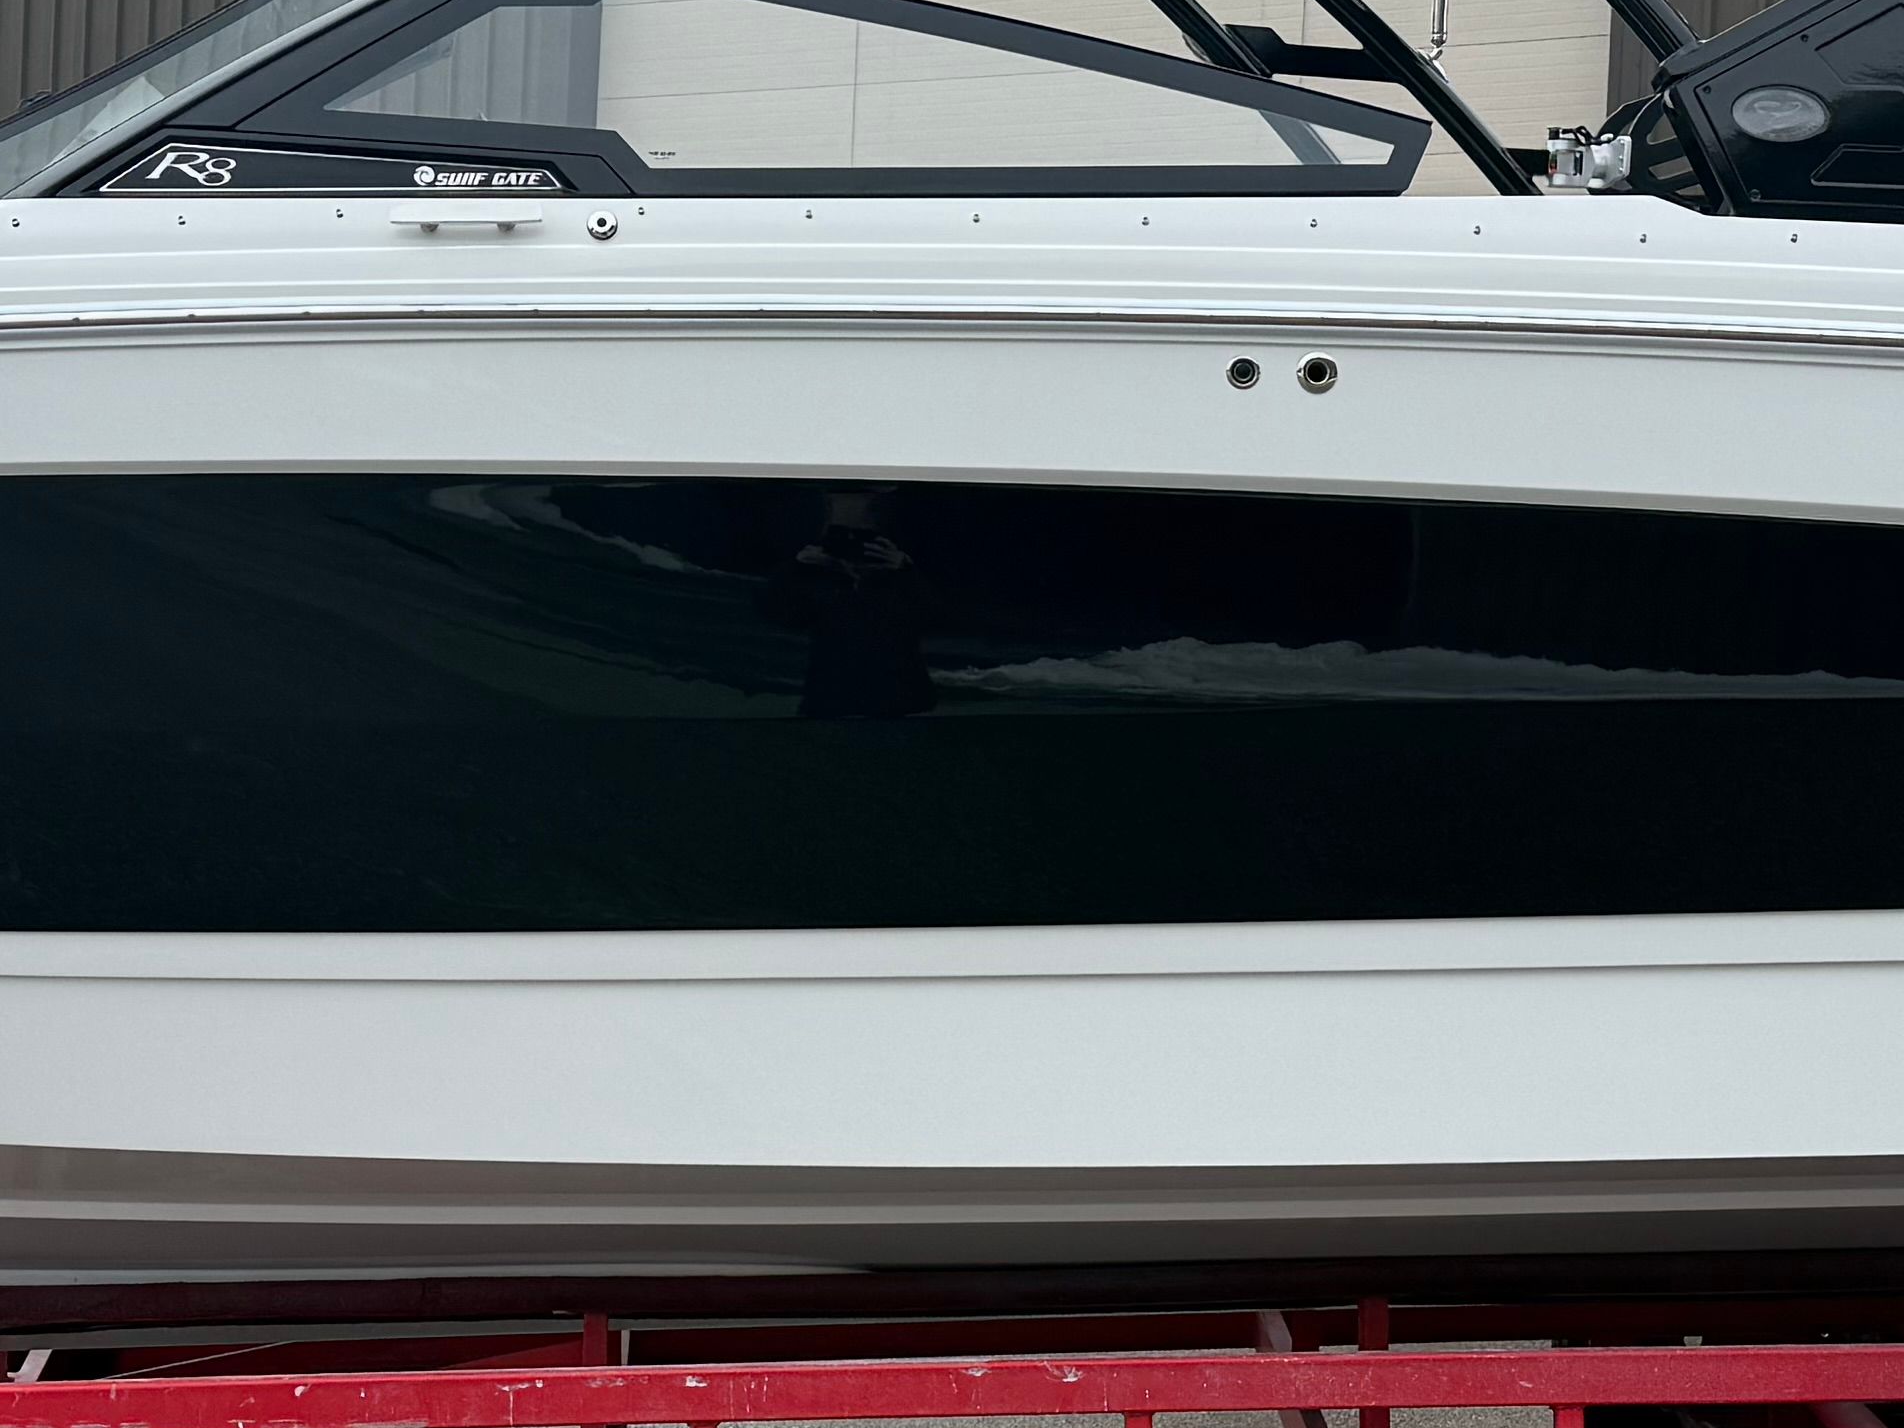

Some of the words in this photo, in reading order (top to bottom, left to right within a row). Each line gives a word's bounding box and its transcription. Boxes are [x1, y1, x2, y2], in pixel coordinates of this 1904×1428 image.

[145, 151, 237, 187] R8
[434, 172, 489, 186] SURF
[491, 172, 543, 186] GATE
